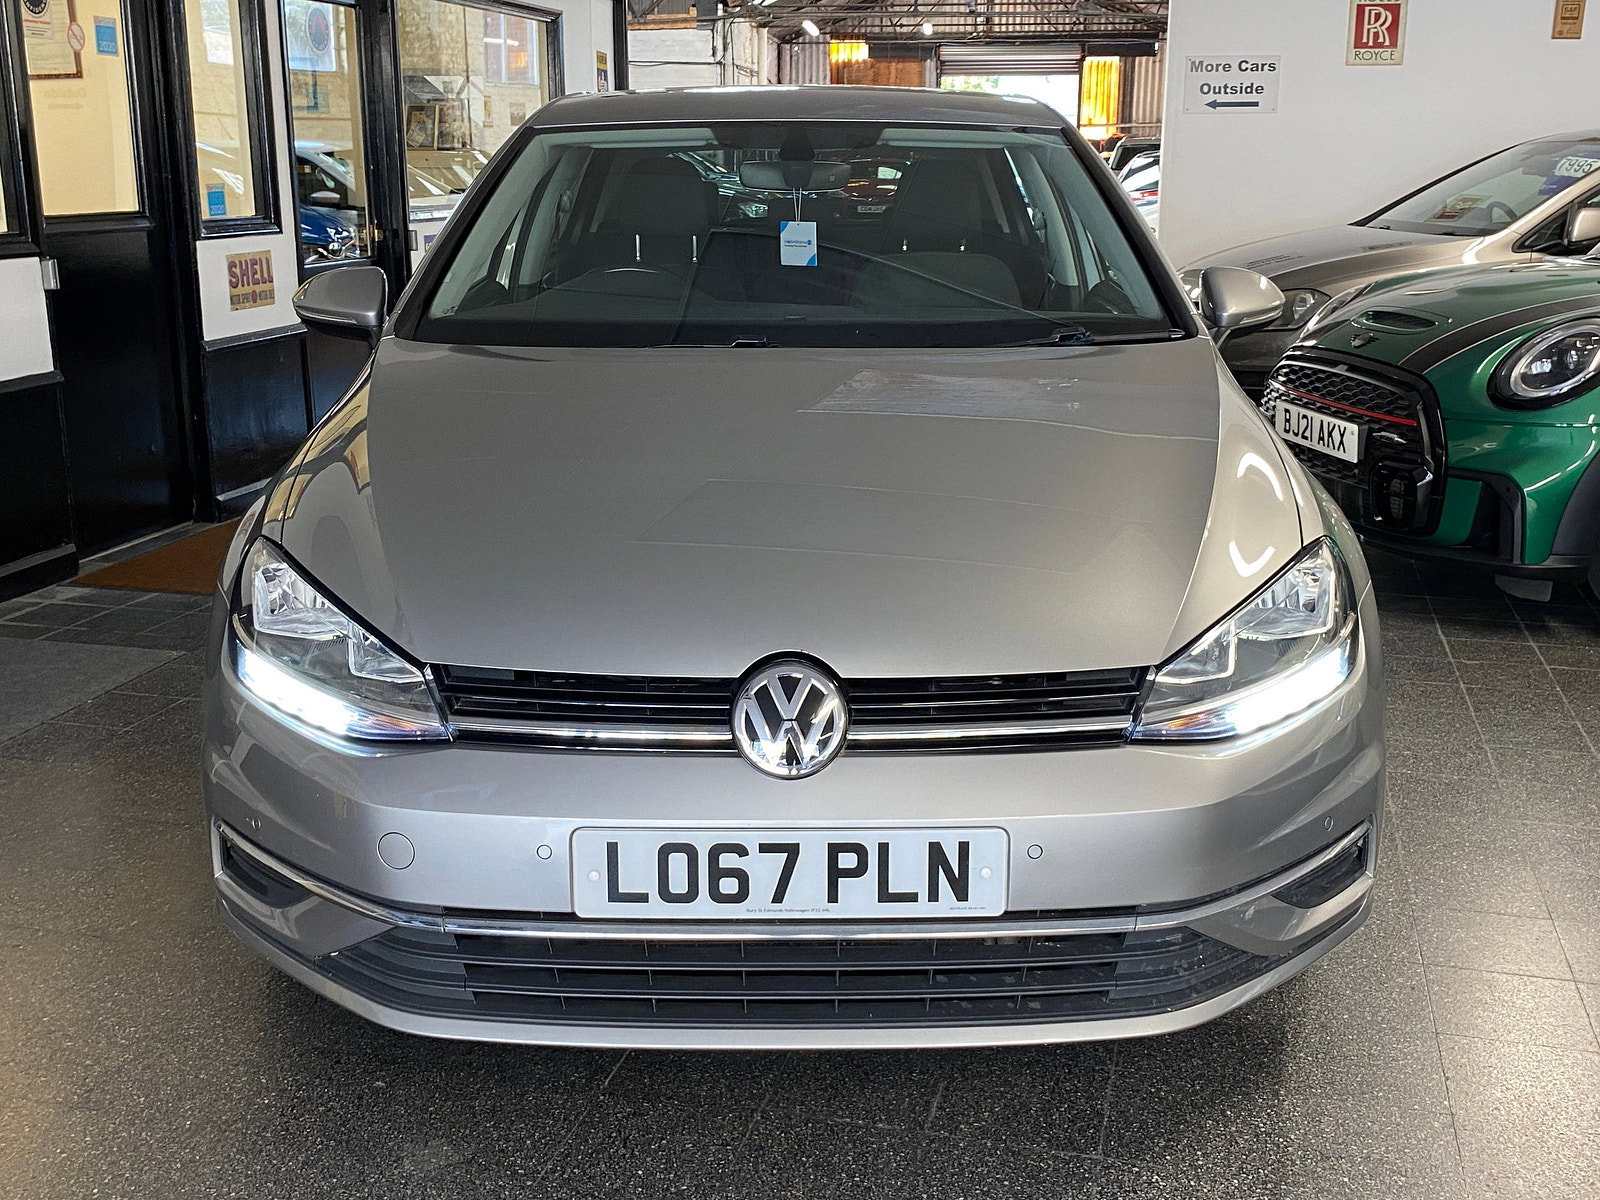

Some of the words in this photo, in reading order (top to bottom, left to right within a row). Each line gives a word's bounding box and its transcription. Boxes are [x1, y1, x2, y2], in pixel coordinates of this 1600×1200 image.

[1190, 60, 1232, 73] More
[1238, 60, 1277, 72] Cars
[1354, 50, 1395, 61] ROYCE
[1199, 82, 1264, 95] Outside
[227, 257, 273, 289] SHELL
[1283, 408, 1313, 442] BJ21
[1317, 419, 1346, 454] AKX
[606, 841, 800, 904] LO67
[827, 841, 970, 904] PLN
